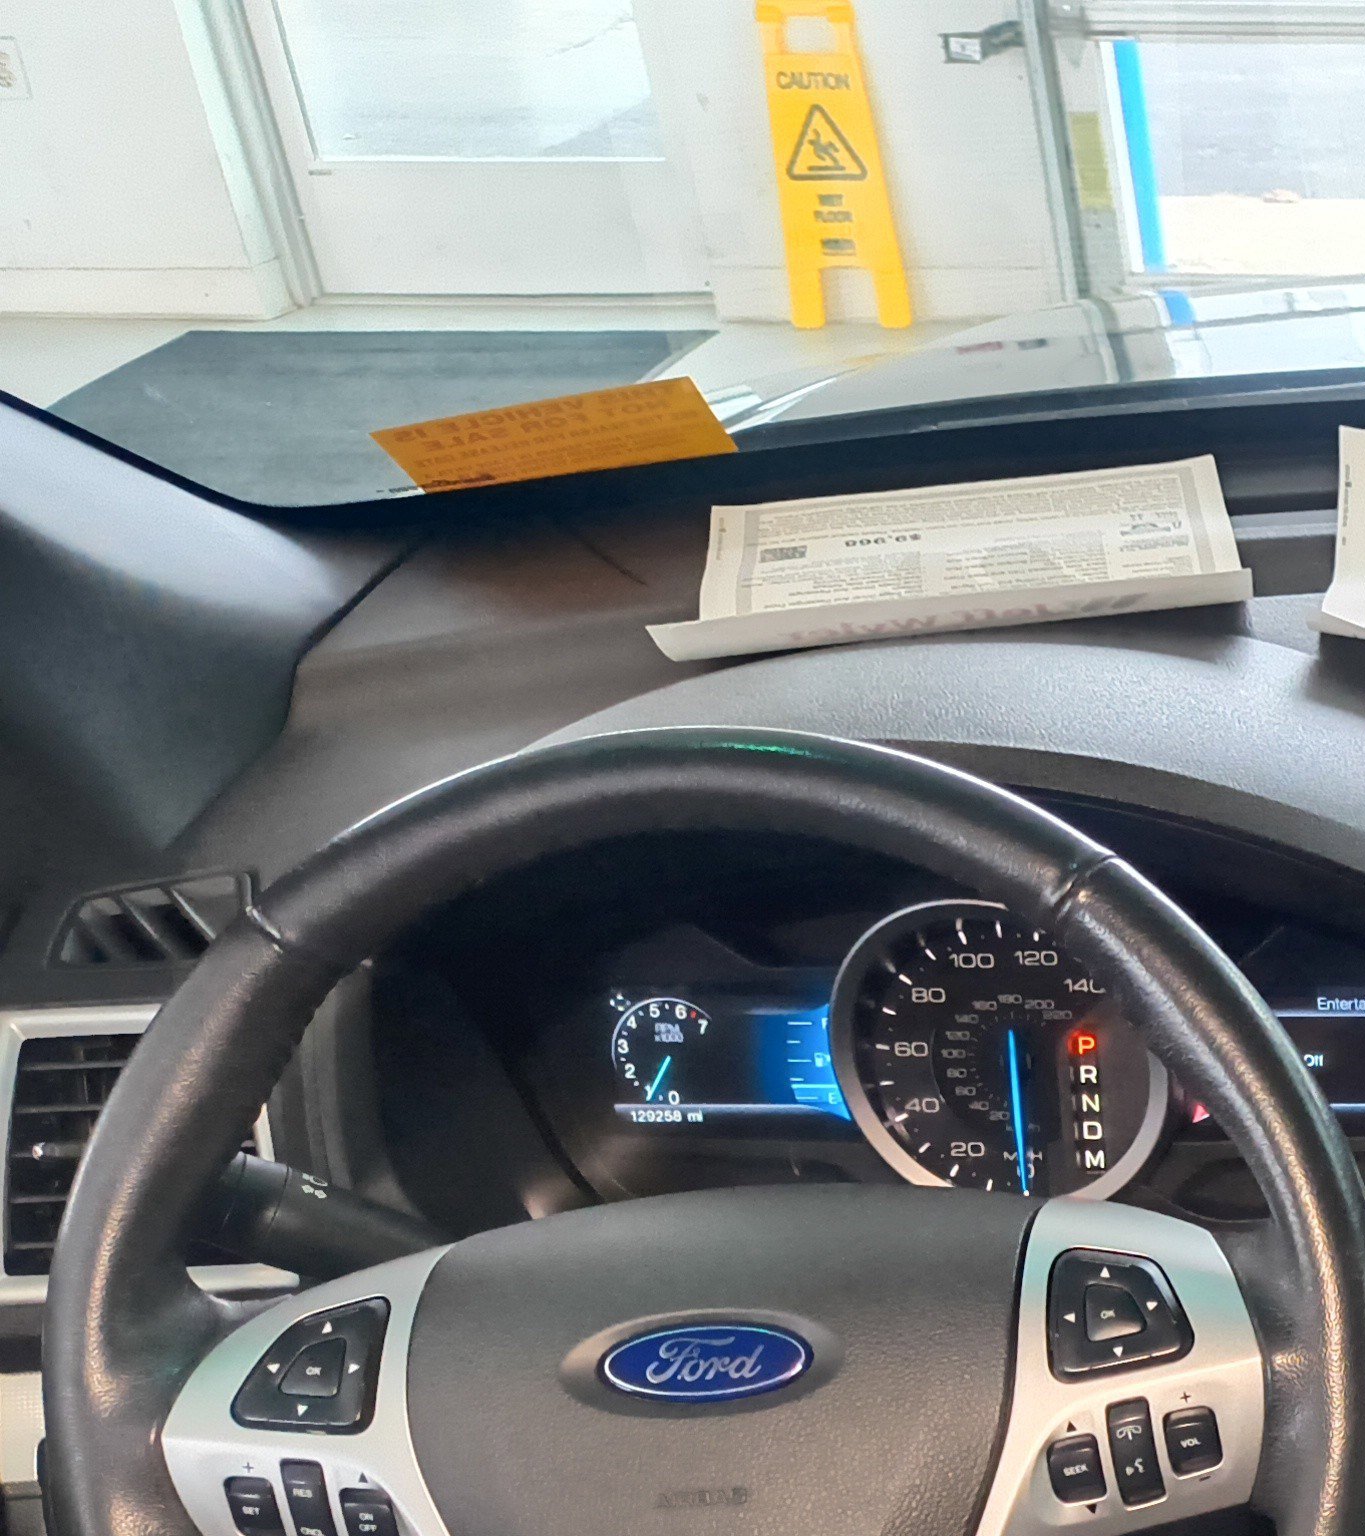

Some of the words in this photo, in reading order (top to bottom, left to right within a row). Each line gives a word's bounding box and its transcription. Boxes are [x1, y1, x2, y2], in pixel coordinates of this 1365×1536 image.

[776, 71, 850, 90] CAUTION
[950, 953, 994, 969] 100
[1015, 951, 1058, 966] 120
[912, 987, 946, 1003] 80
[649, 1004, 660, 1018] 5
[675, 1005, 687, 1019] 6
[626, 1015, 637, 1029] 4
[698, 1019, 708, 1035] 7
[617, 1039, 629, 1054] 3
[894, 1042, 929, 1057] 60
[1078, 1036, 1095, 1054] P
[624, 1063, 636, 1079] 2
[1080, 1065, 1097, 1084] R
[668, 1091, 680, 1105] 0
[905, 1098, 940, 1113] 40
[1082, 1094, 1100, 1112] N
[687, 1110, 703, 1123] mi
[1083, 1121, 1103, 1140] D
[950, 1141, 985, 1157] 20
[1003, 1150, 1043, 1162] MH
[1084, 1149, 1105, 1169] M
[645, 1336, 761, 1384] Ford
[305, 1366, 322, 1376] OK
[1180, 1437, 1201, 1449] VOL
[1063, 1463, 1088, 1477] SEEK
[242, 1506, 260, 1516] SET
[358, 1512, 374, 1521] ON
[358, 1523, 378, 1533] OFF
